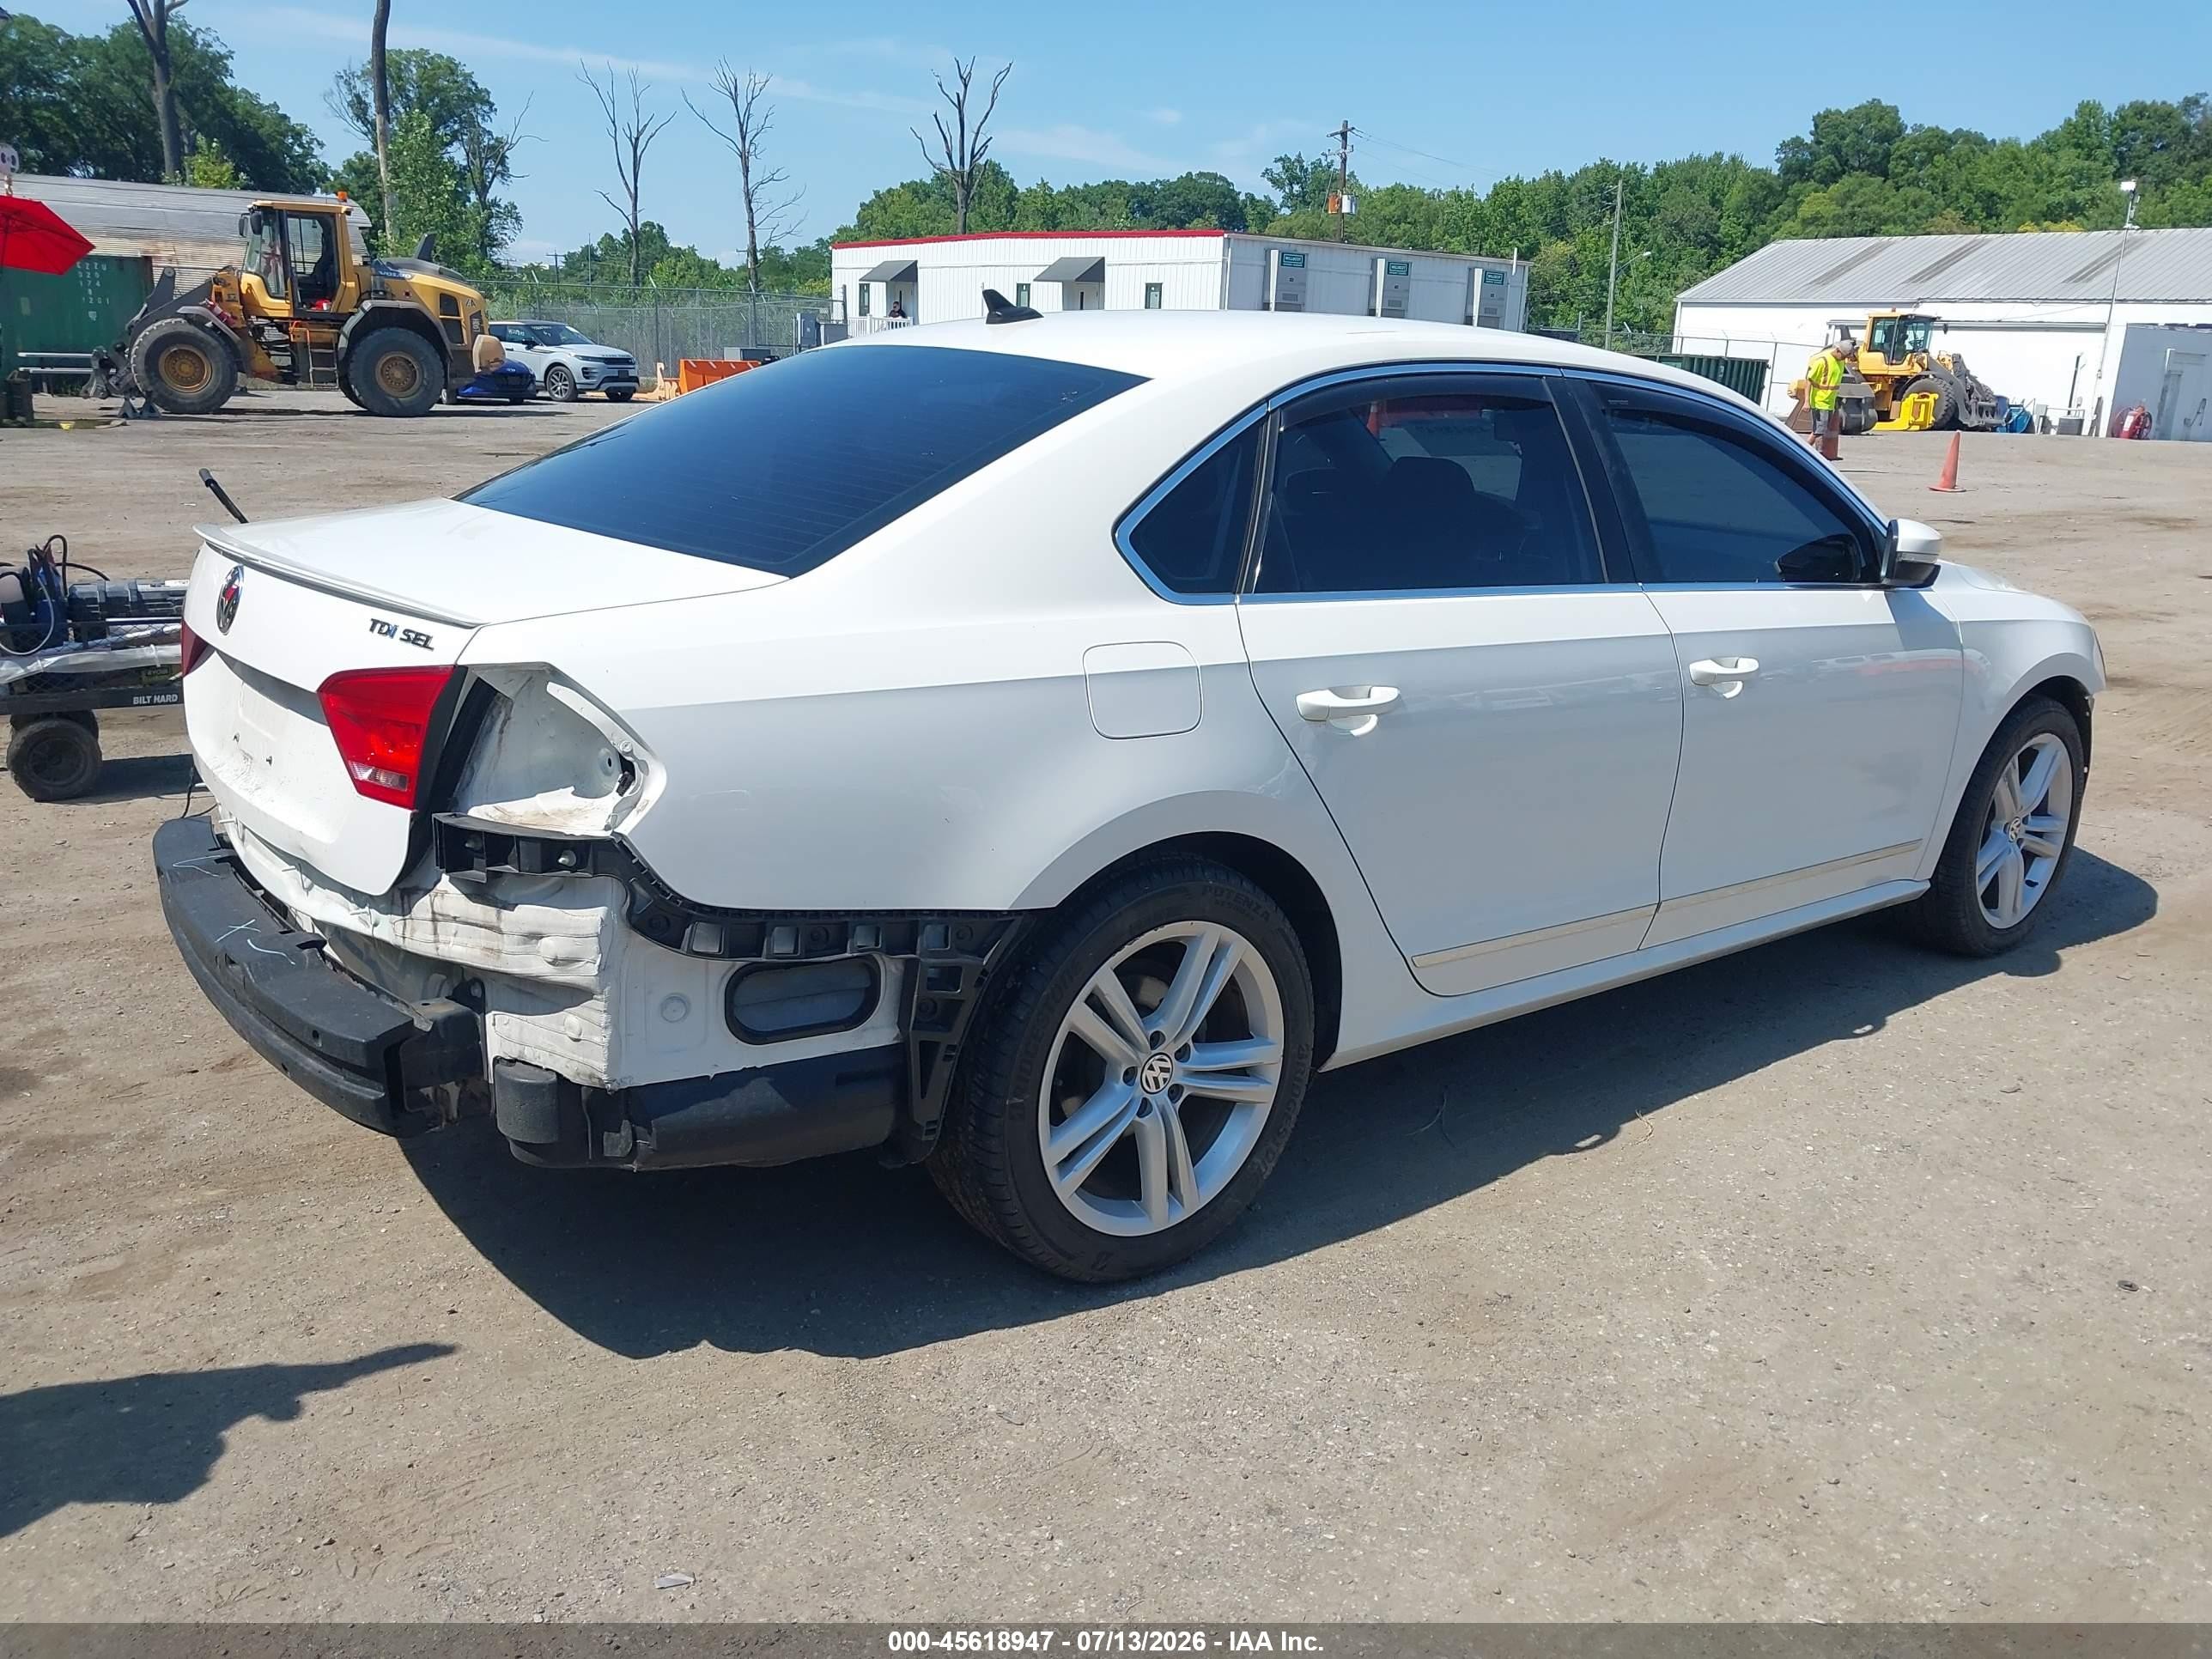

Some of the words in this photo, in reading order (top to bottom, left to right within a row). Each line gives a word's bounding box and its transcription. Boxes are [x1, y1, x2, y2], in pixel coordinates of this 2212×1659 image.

[379, 270, 411, 279] VOLVO
[399, 629, 434, 652] SEL
[133, 696, 152, 705] BILT
[154, 694, 179, 704] HARD
